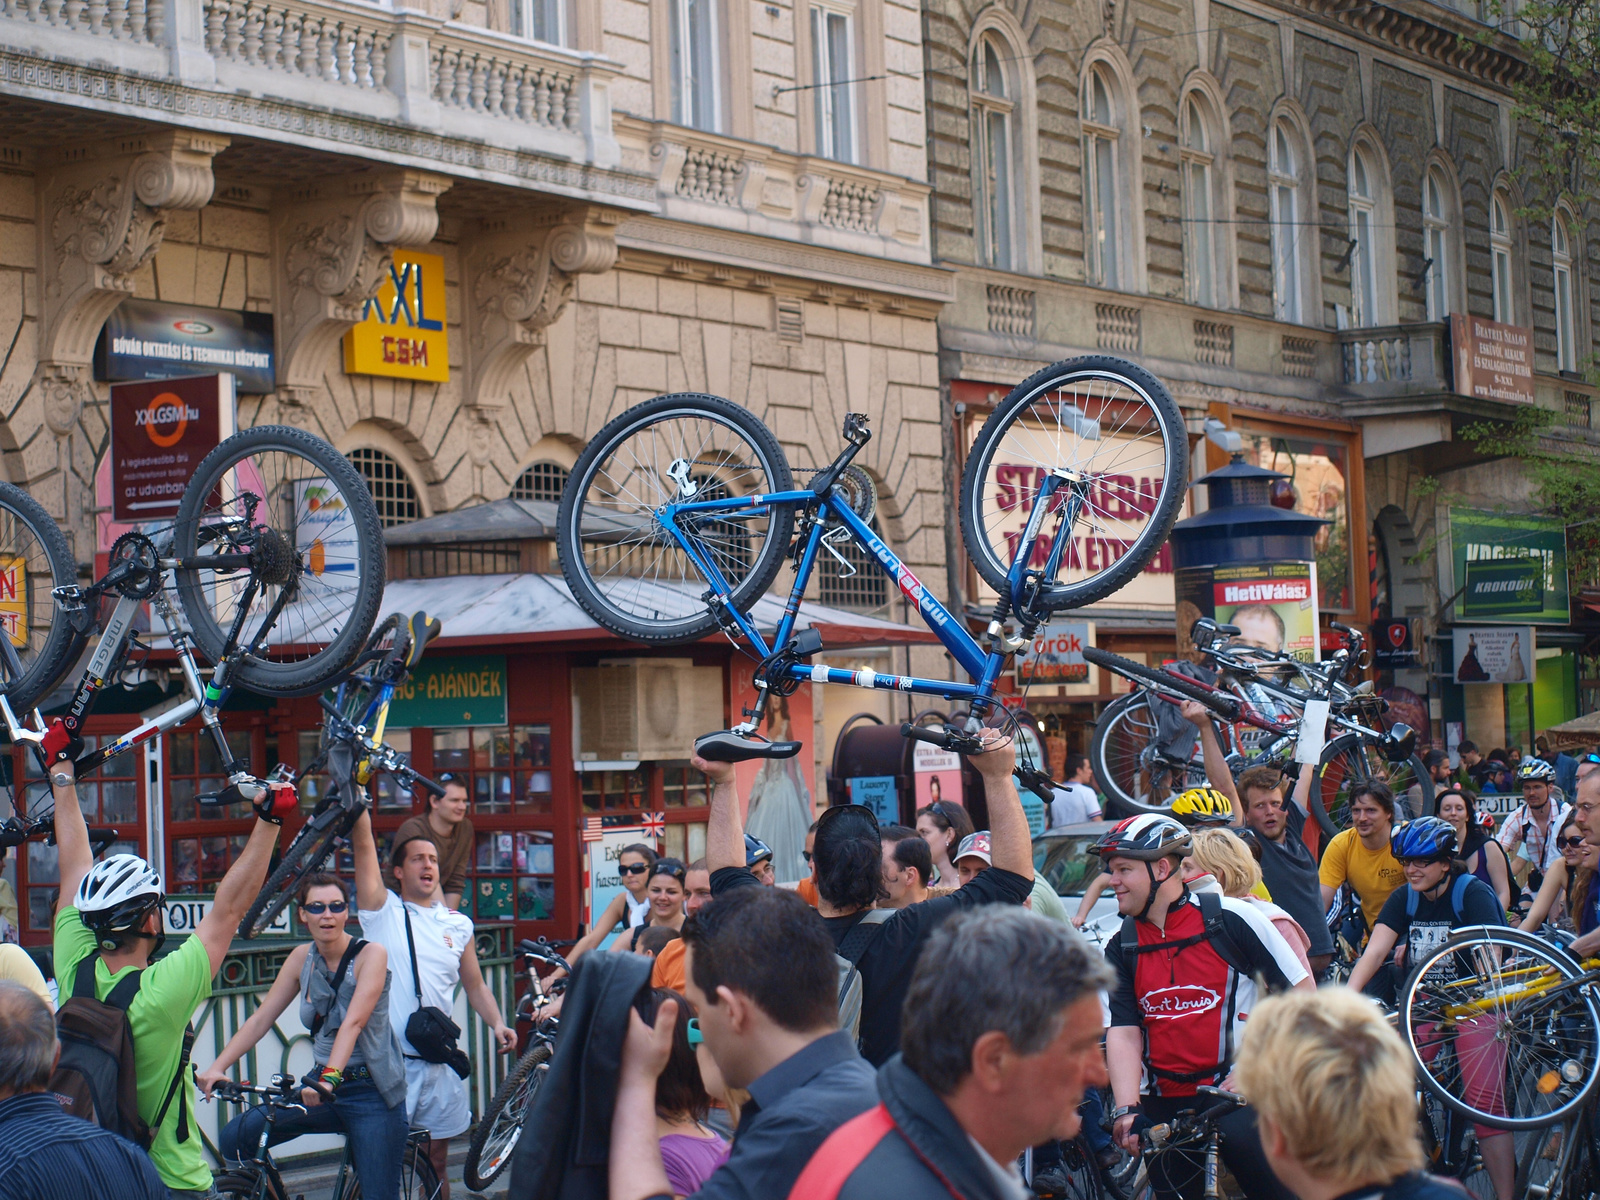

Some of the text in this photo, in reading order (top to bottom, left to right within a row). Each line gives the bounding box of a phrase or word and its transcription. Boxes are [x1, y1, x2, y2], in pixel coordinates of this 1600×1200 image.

[142, 340, 181, 361] OKTATÁSI
[181, 343, 192, 362] ÉS
[193, 346, 234, 366] TECHNIKAI
[235, 347, 270, 369] KÖZPONT
[382, 335, 429, 368] GSM
[135, 403, 200, 426] XXLGSM.hu
[125, 485, 137, 498] az
[1003, 523, 1082, 571] TRK
[1225, 583, 1308, 603] HetiVálasz
[1474, 579, 1534, 594] KROKODIL
[1026, 633, 1083, 655] örök
[427, 665, 501, 699] AJÁNDÉK
[1143, 995, 1212, 1014] Port Louis
